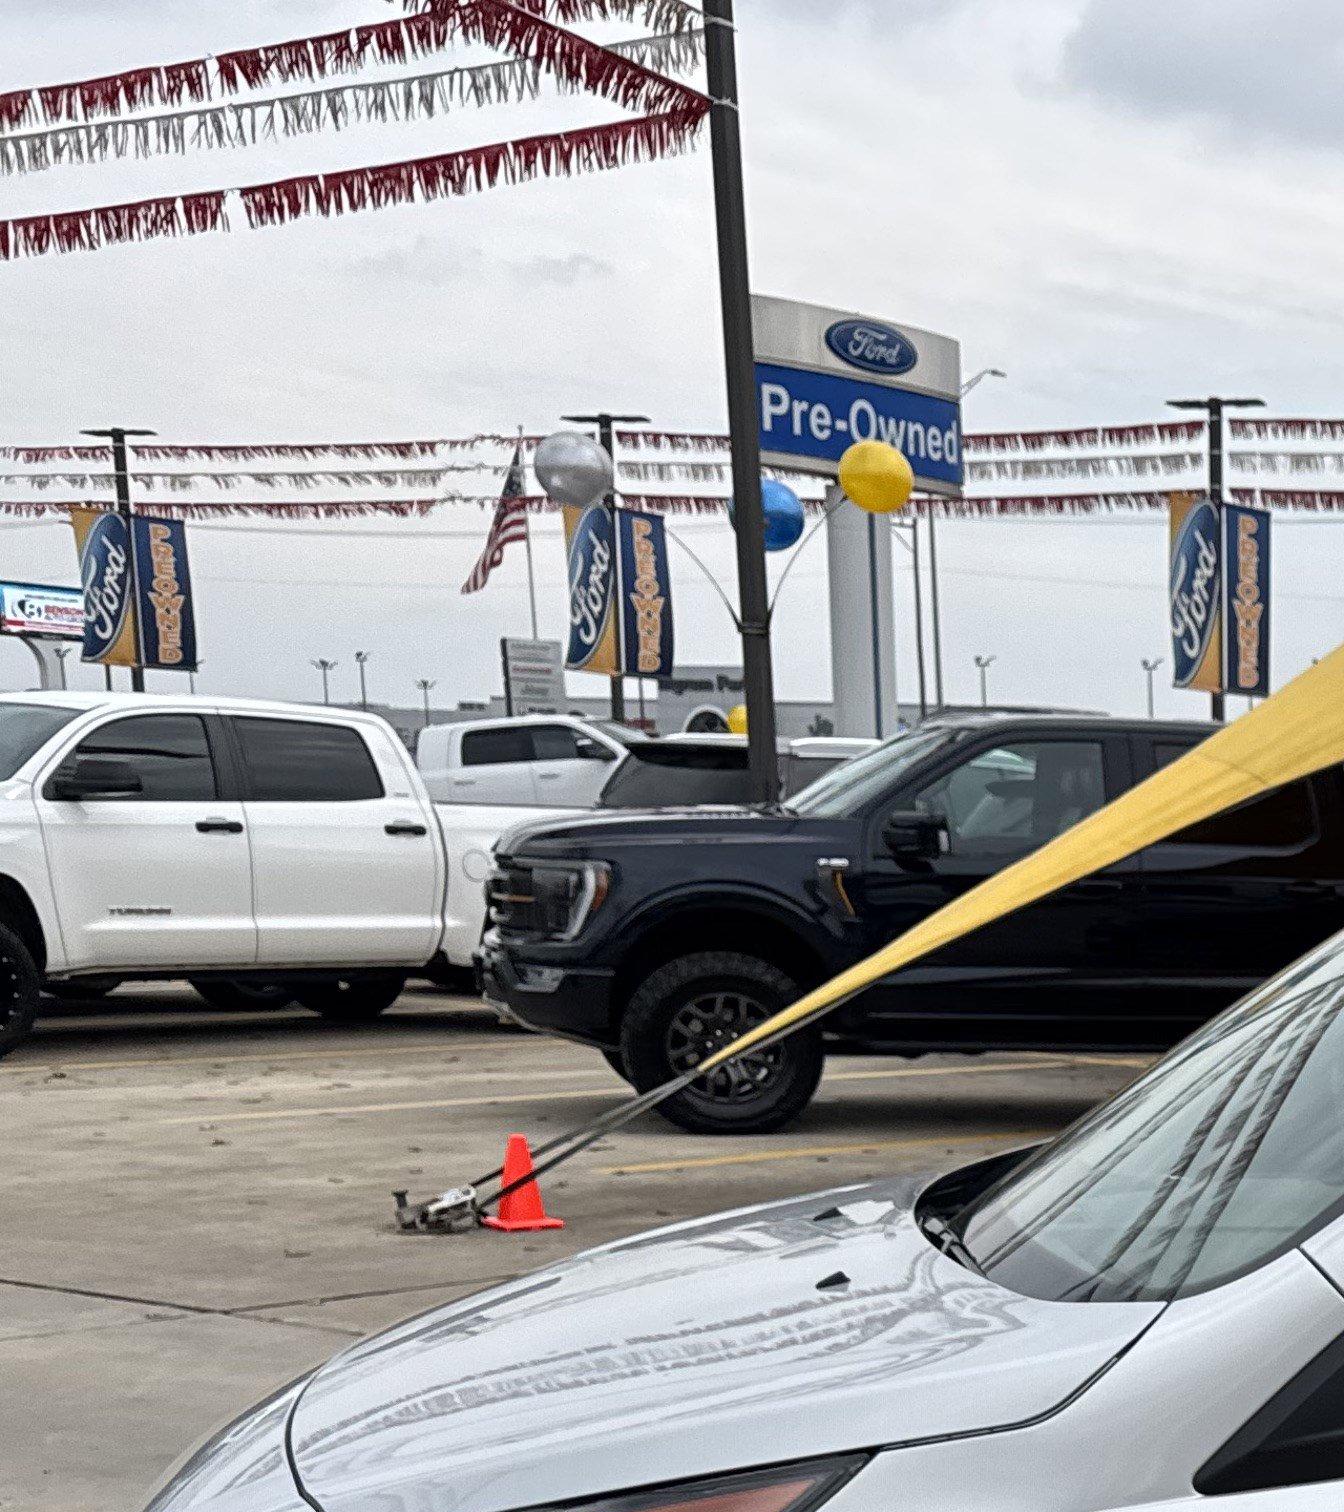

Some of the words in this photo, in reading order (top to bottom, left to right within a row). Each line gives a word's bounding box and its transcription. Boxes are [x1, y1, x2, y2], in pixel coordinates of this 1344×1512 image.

[849, 326, 903, 366] Ford
[760, 381, 959, 465] Pre-Owned
[83, 534, 127, 641] Ford
[571, 529, 611, 646] Ford
[1171, 529, 1218, 660] Ford
